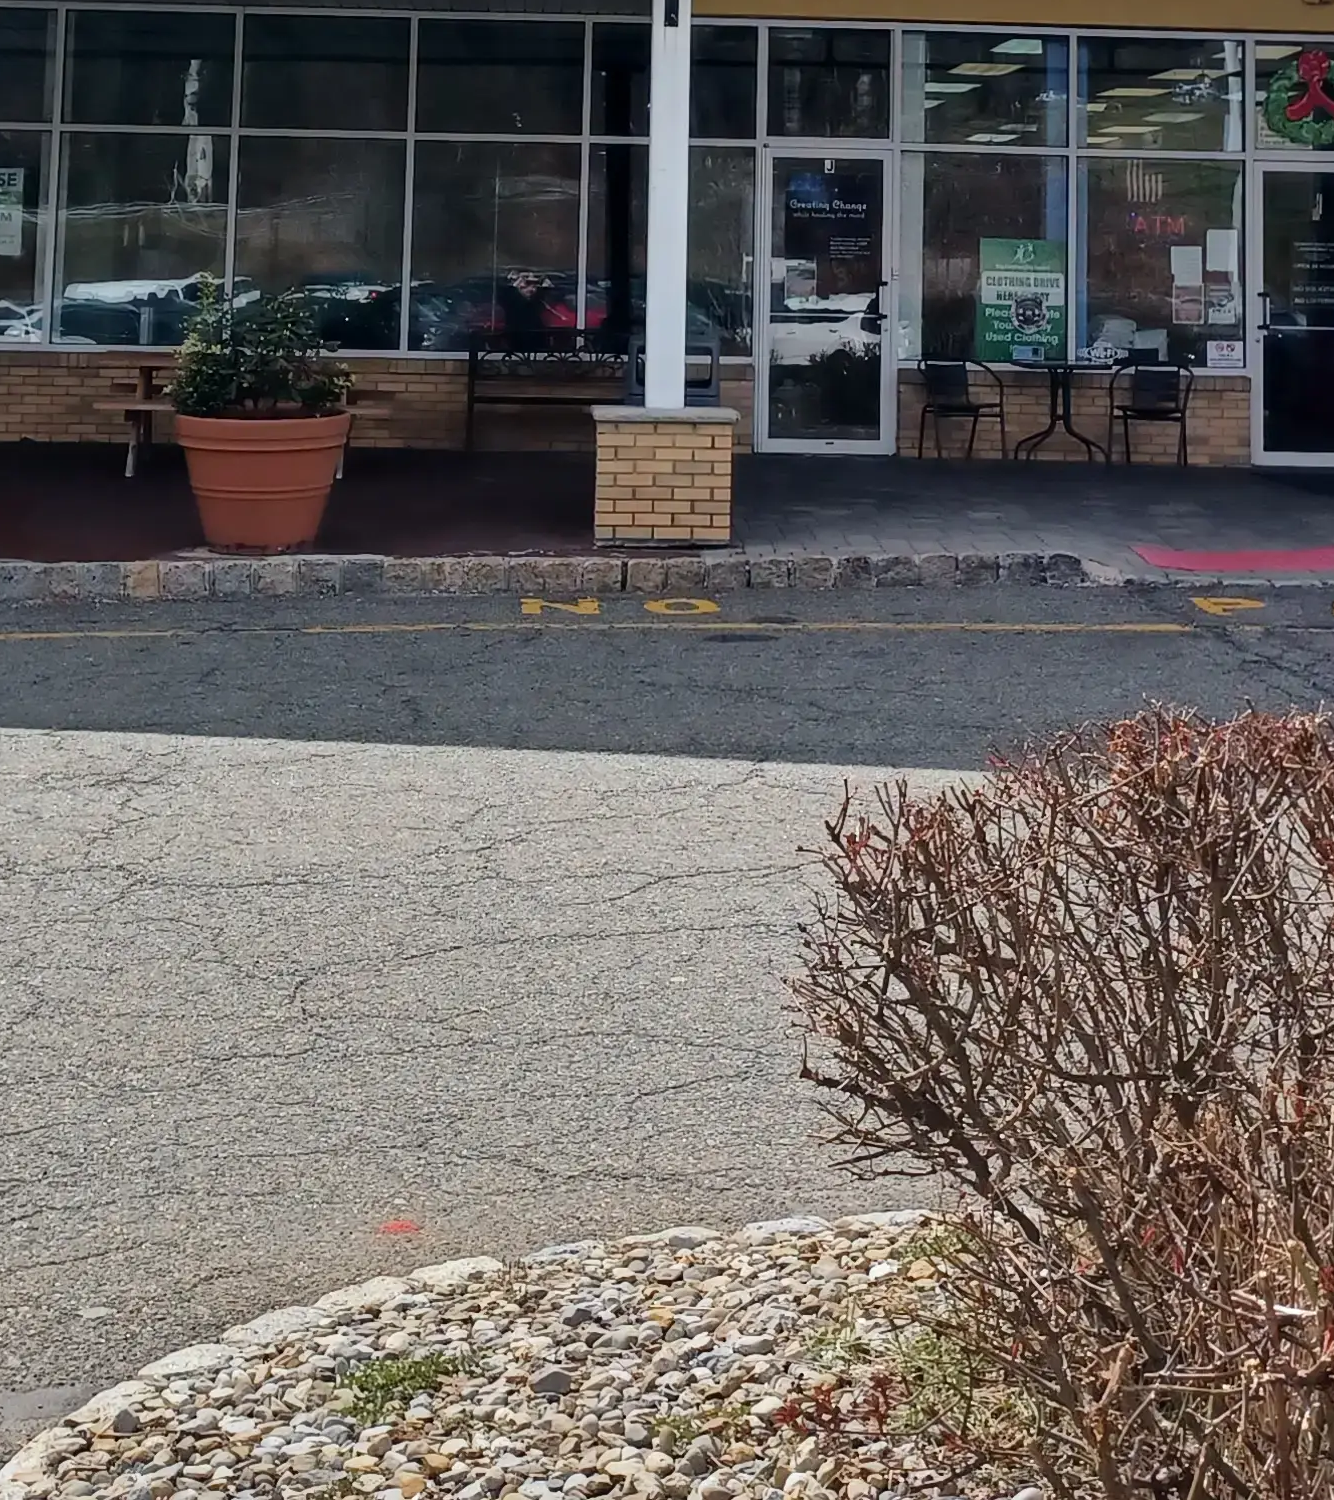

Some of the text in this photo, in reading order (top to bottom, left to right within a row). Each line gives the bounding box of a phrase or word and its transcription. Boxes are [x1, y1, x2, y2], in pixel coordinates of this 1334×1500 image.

[790, 199, 867, 211] Creating Change
[1134, 215, 1185, 235] ATM
[986, 276, 1061, 288] CLOTHING DRIVE
[985, 308, 1012, 317] Plea
[993, 321, 1014, 330] You
[985, 333, 1059, 346] Used Clothing
[519, 597, 723, 616] NO
